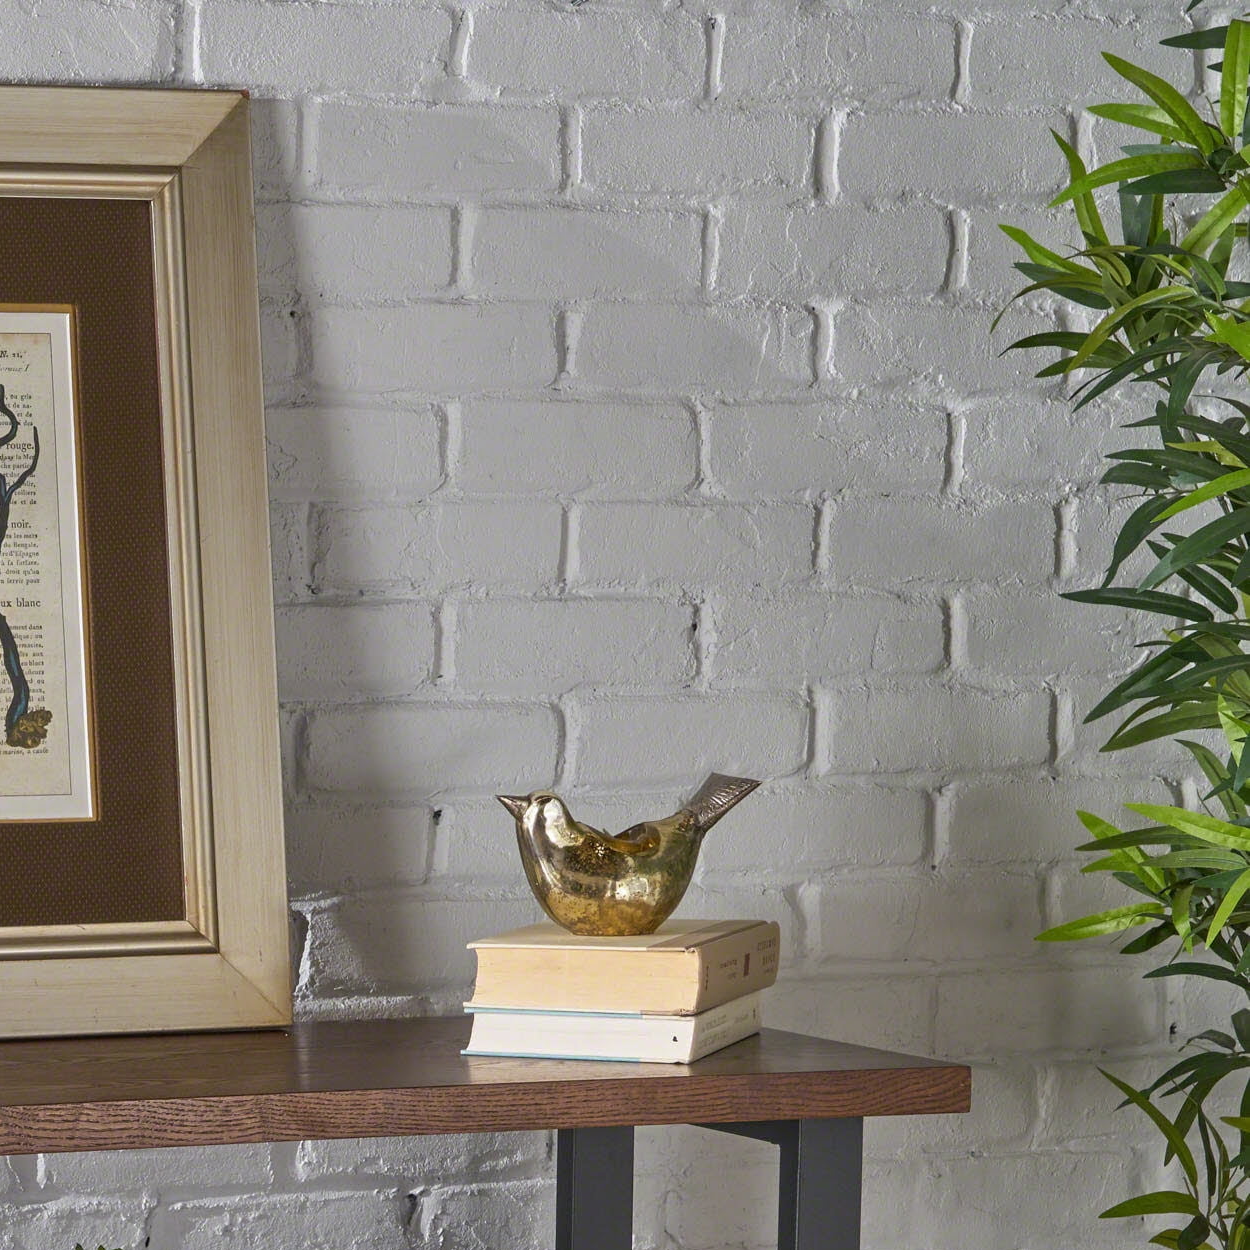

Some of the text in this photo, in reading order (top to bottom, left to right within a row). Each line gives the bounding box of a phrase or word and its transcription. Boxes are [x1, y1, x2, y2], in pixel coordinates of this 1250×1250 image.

[6, 442, 35, 453] rouge.
[11, 519, 31, 529] noir.
[16, 597, 42, 608] blanc
